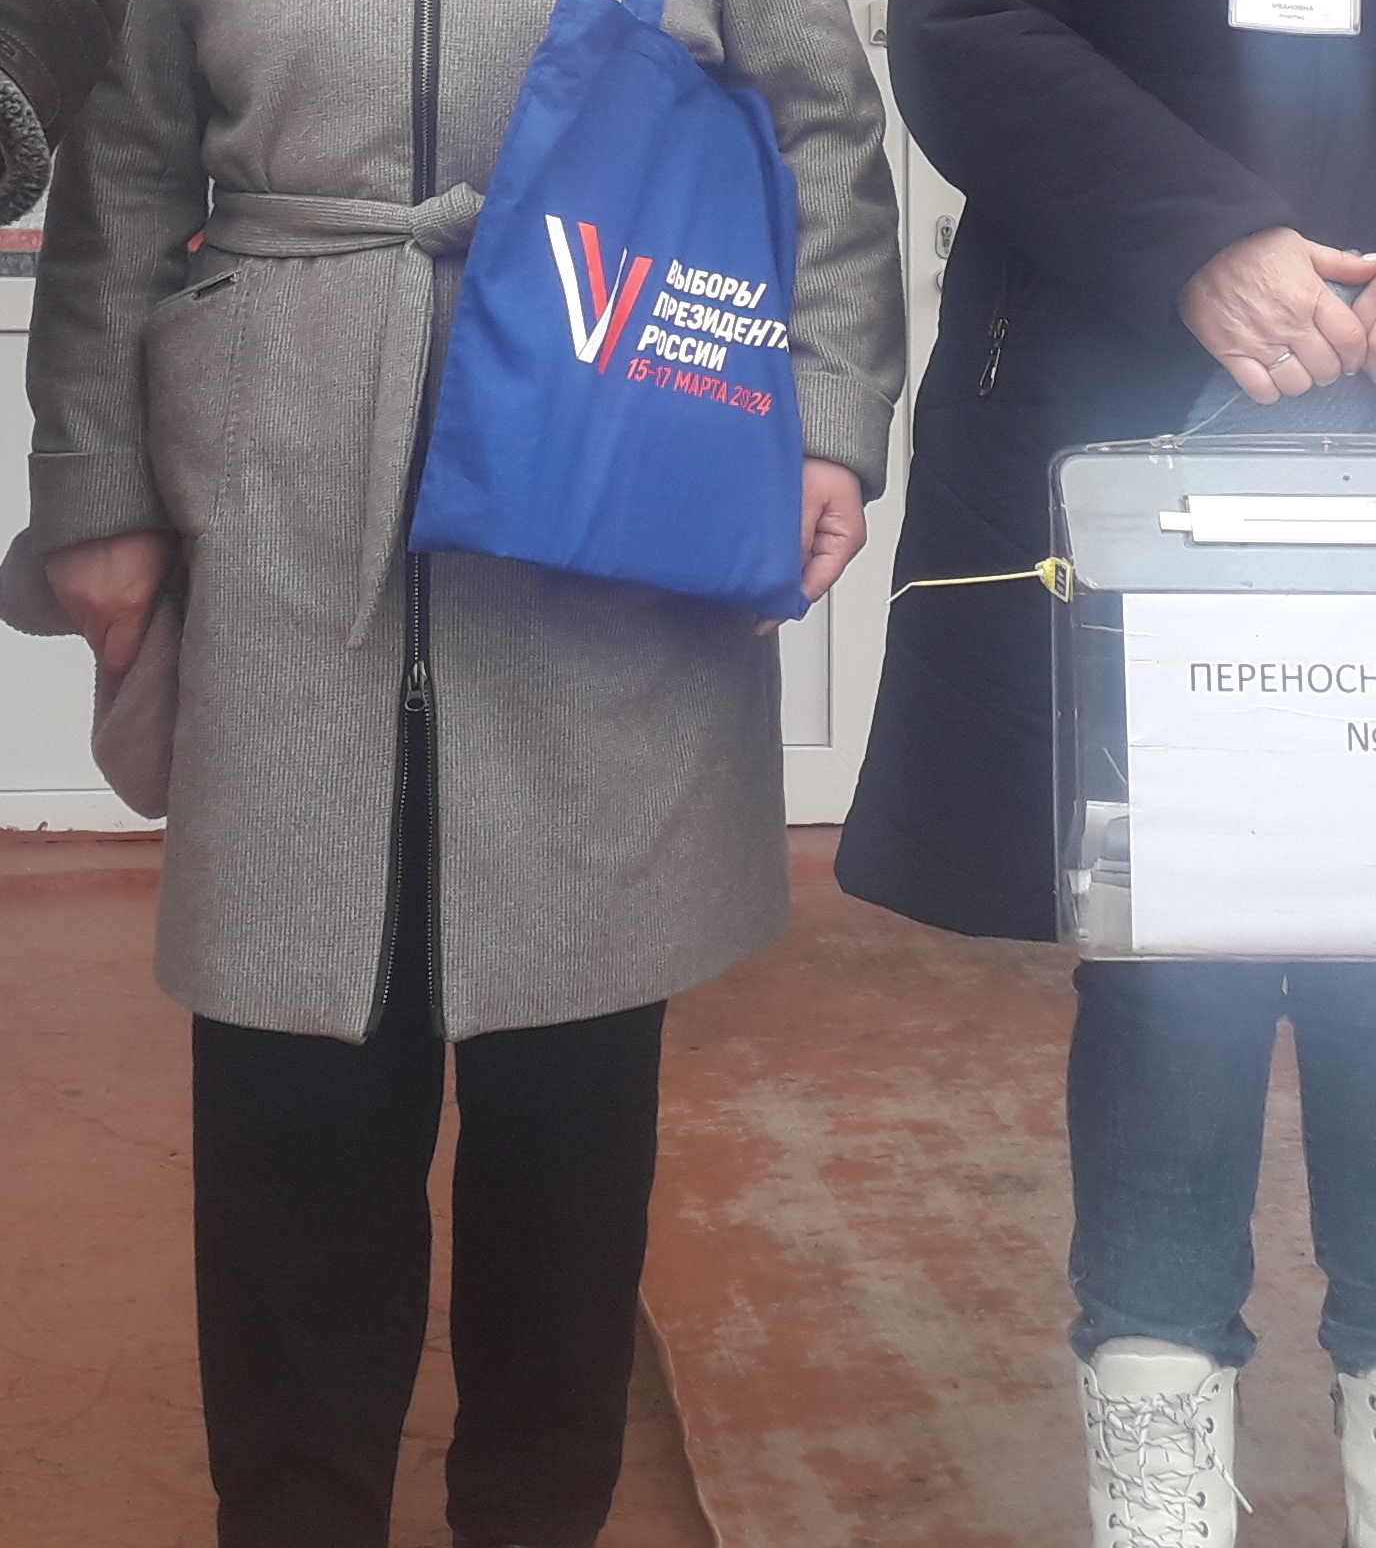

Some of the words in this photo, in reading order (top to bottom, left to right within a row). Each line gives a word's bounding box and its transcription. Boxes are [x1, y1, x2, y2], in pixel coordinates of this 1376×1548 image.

[666, 259, 767, 309] ВЫБОРЫ
[637, 324, 728, 372] РОССИИ
[627, 357, 673, 388] 15-17
[673, 370, 728, 403] МАРТА
[729, 385, 773, 416] 2024
